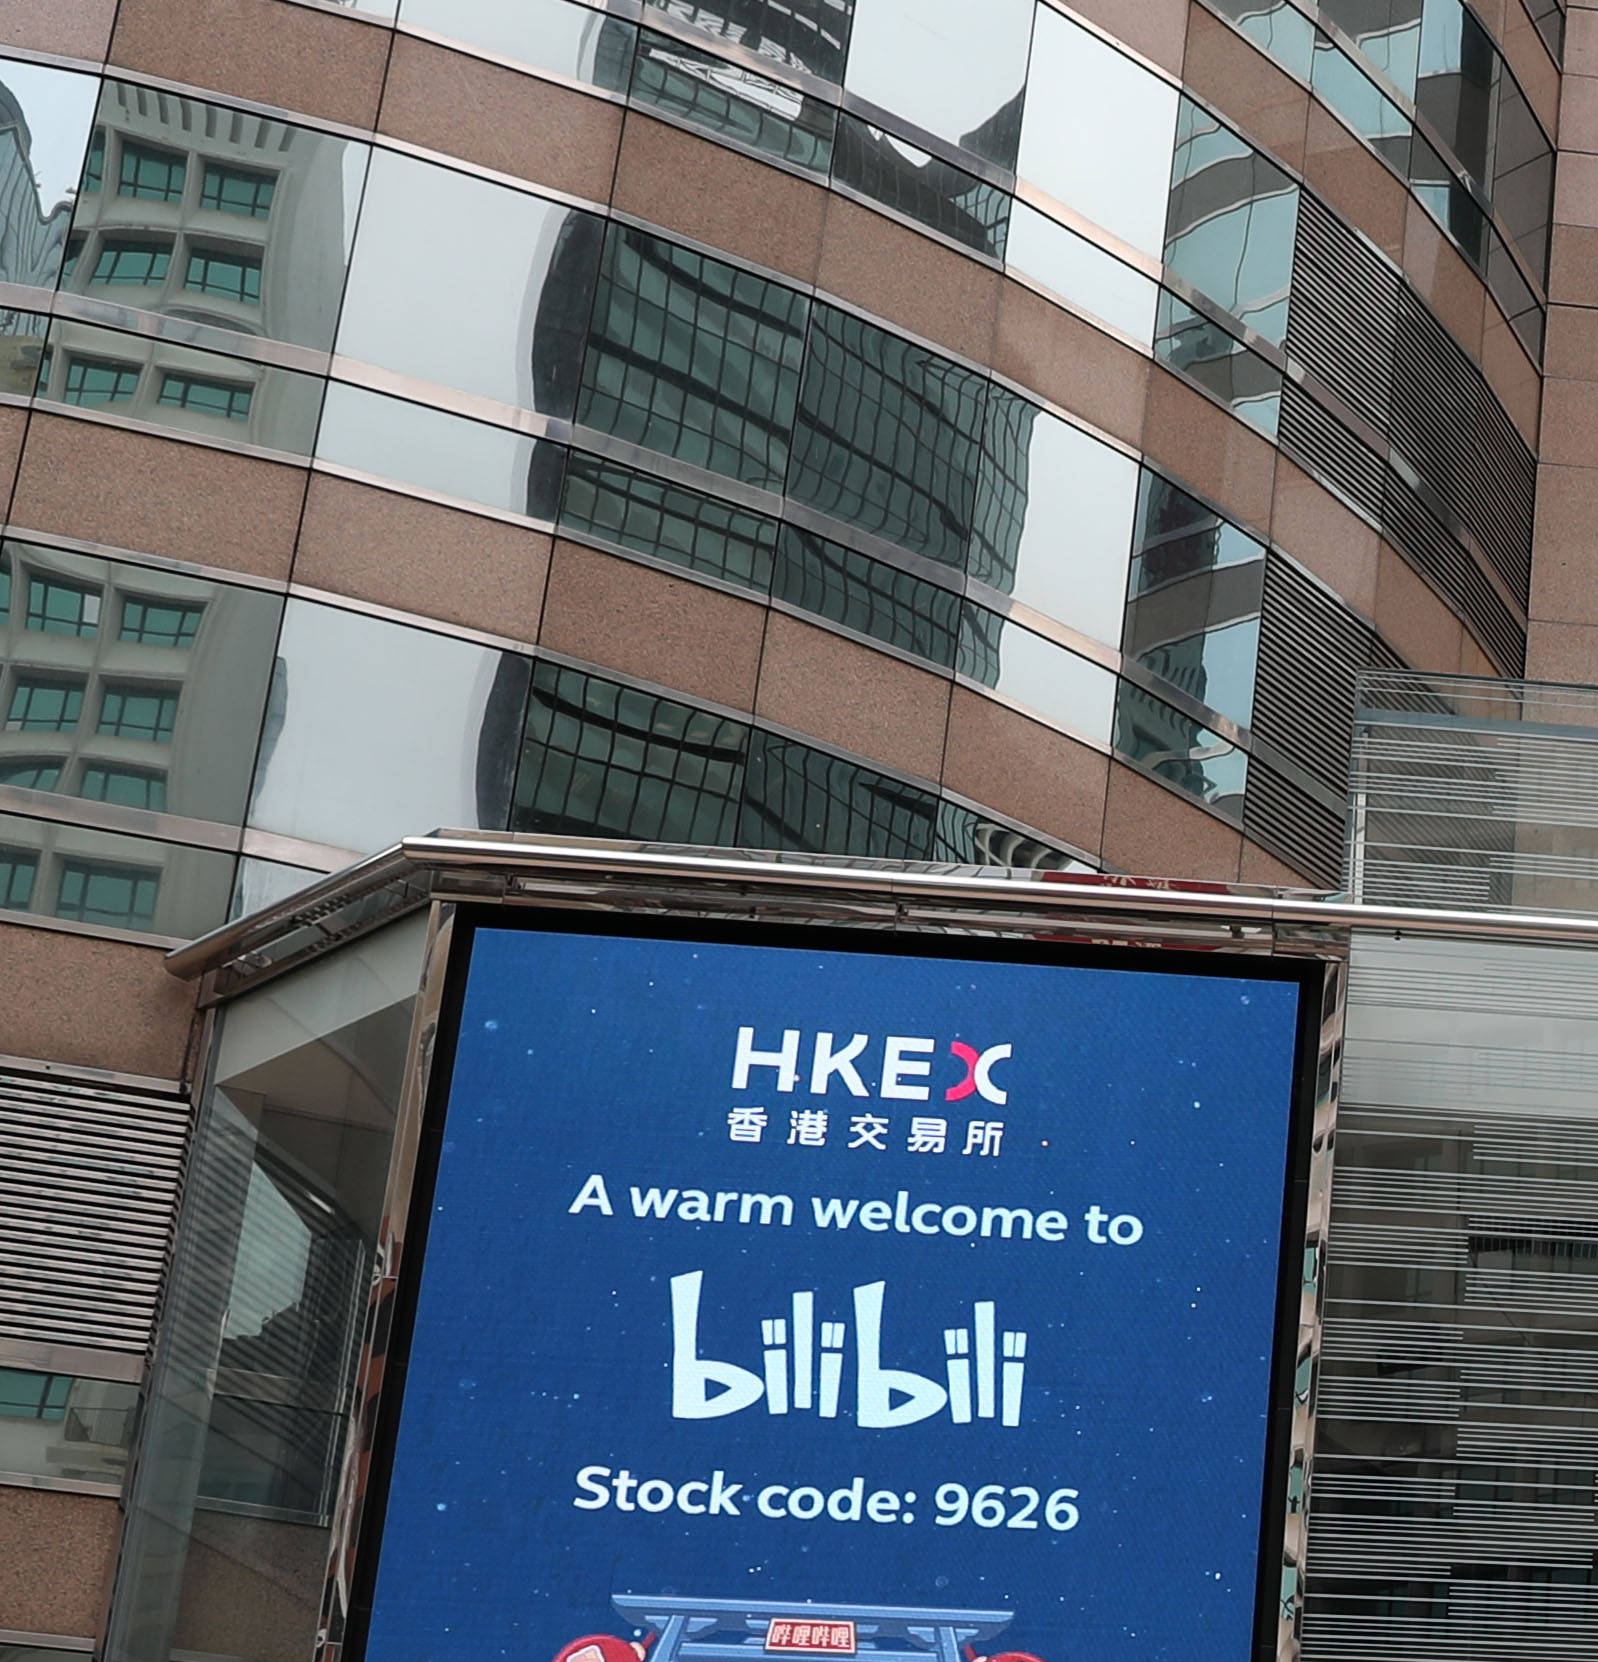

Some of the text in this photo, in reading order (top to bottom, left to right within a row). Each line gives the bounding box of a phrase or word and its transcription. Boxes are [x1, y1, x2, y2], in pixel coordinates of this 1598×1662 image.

[728, 1107, 1003, 1156] 香港交易所
[569, 1175, 1142, 1244] A warm welcome to
[670, 1271, 1026, 1428] bilibili
[574, 1466, 1078, 1530] Stock code: 9626
